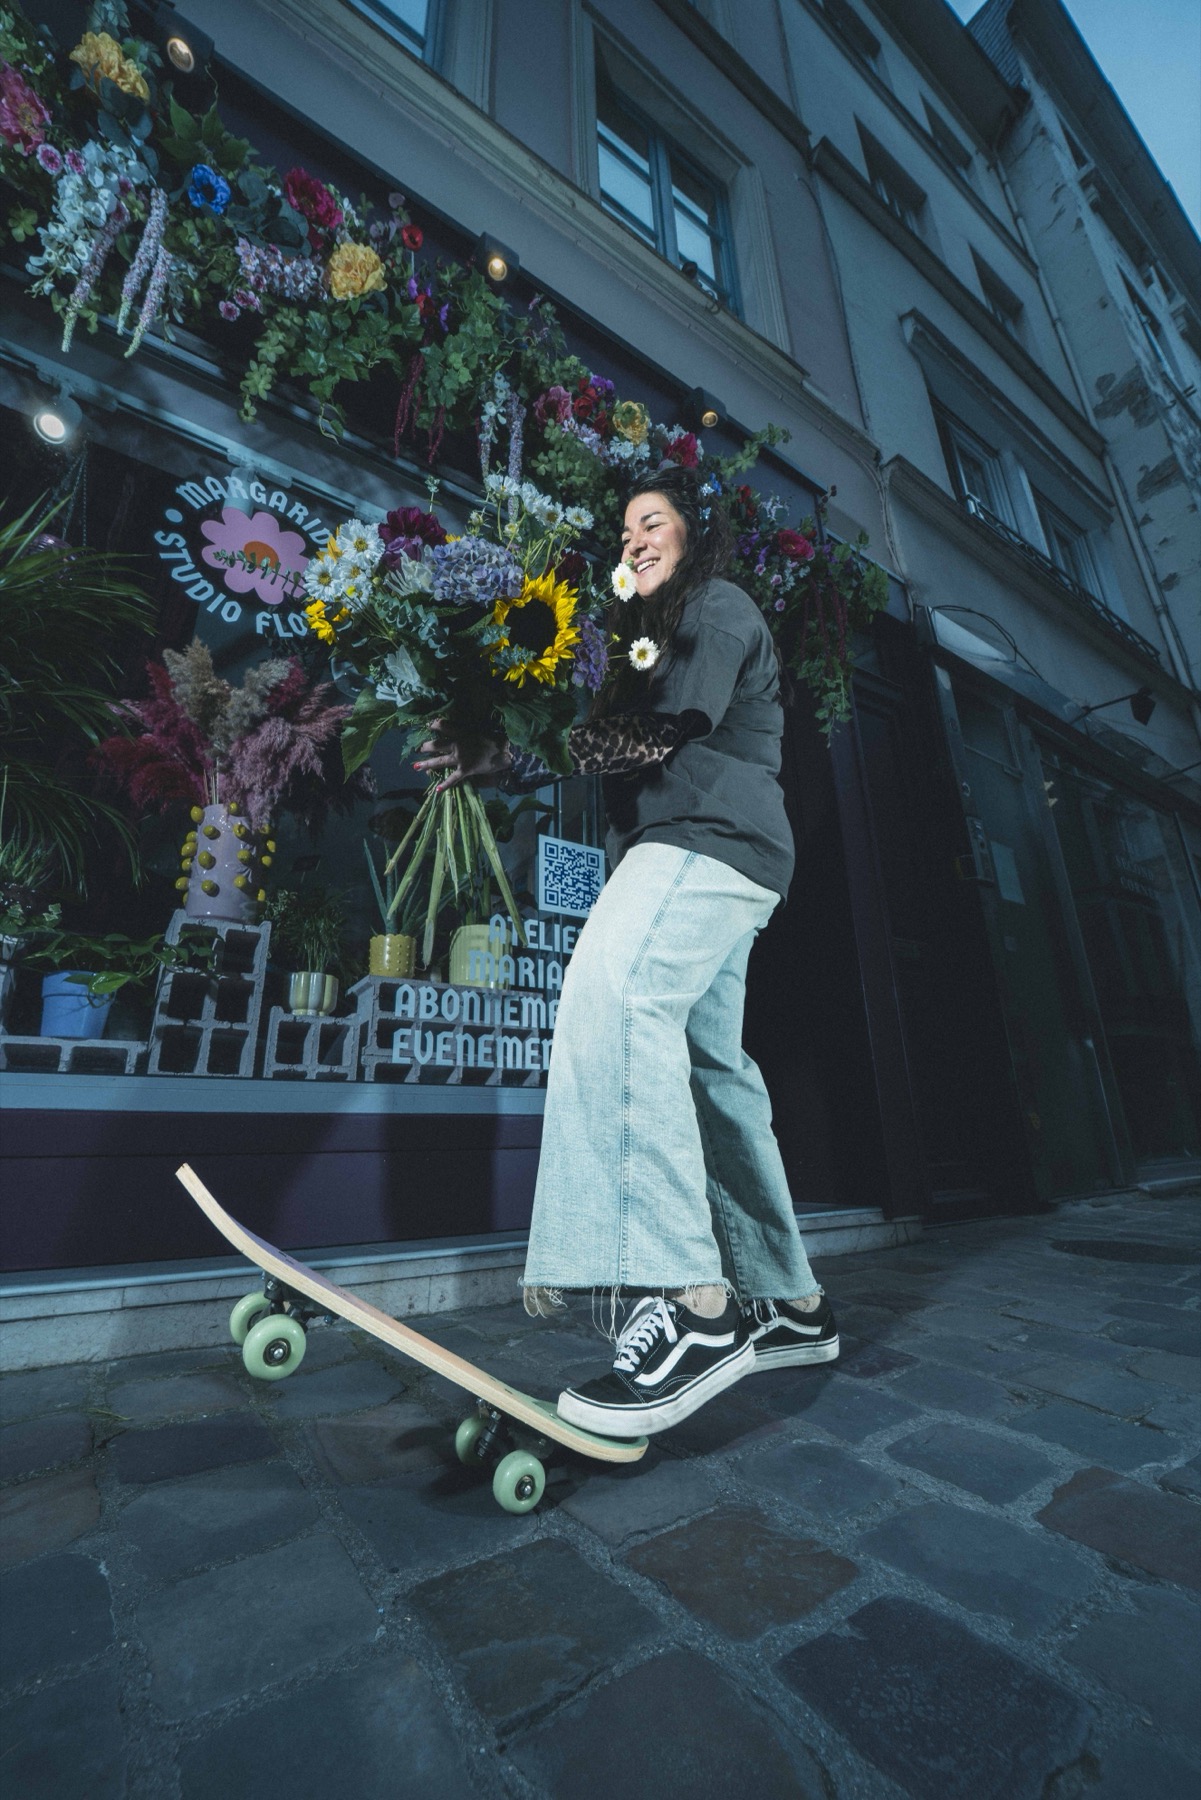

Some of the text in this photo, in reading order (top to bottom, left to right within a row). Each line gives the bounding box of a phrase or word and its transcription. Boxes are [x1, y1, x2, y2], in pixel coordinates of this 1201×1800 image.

[175, 476, 333, 552] MARGARID
[154, 530, 309, 638] STUDIO FLO
[489, 913, 582, 955] ATELIE
